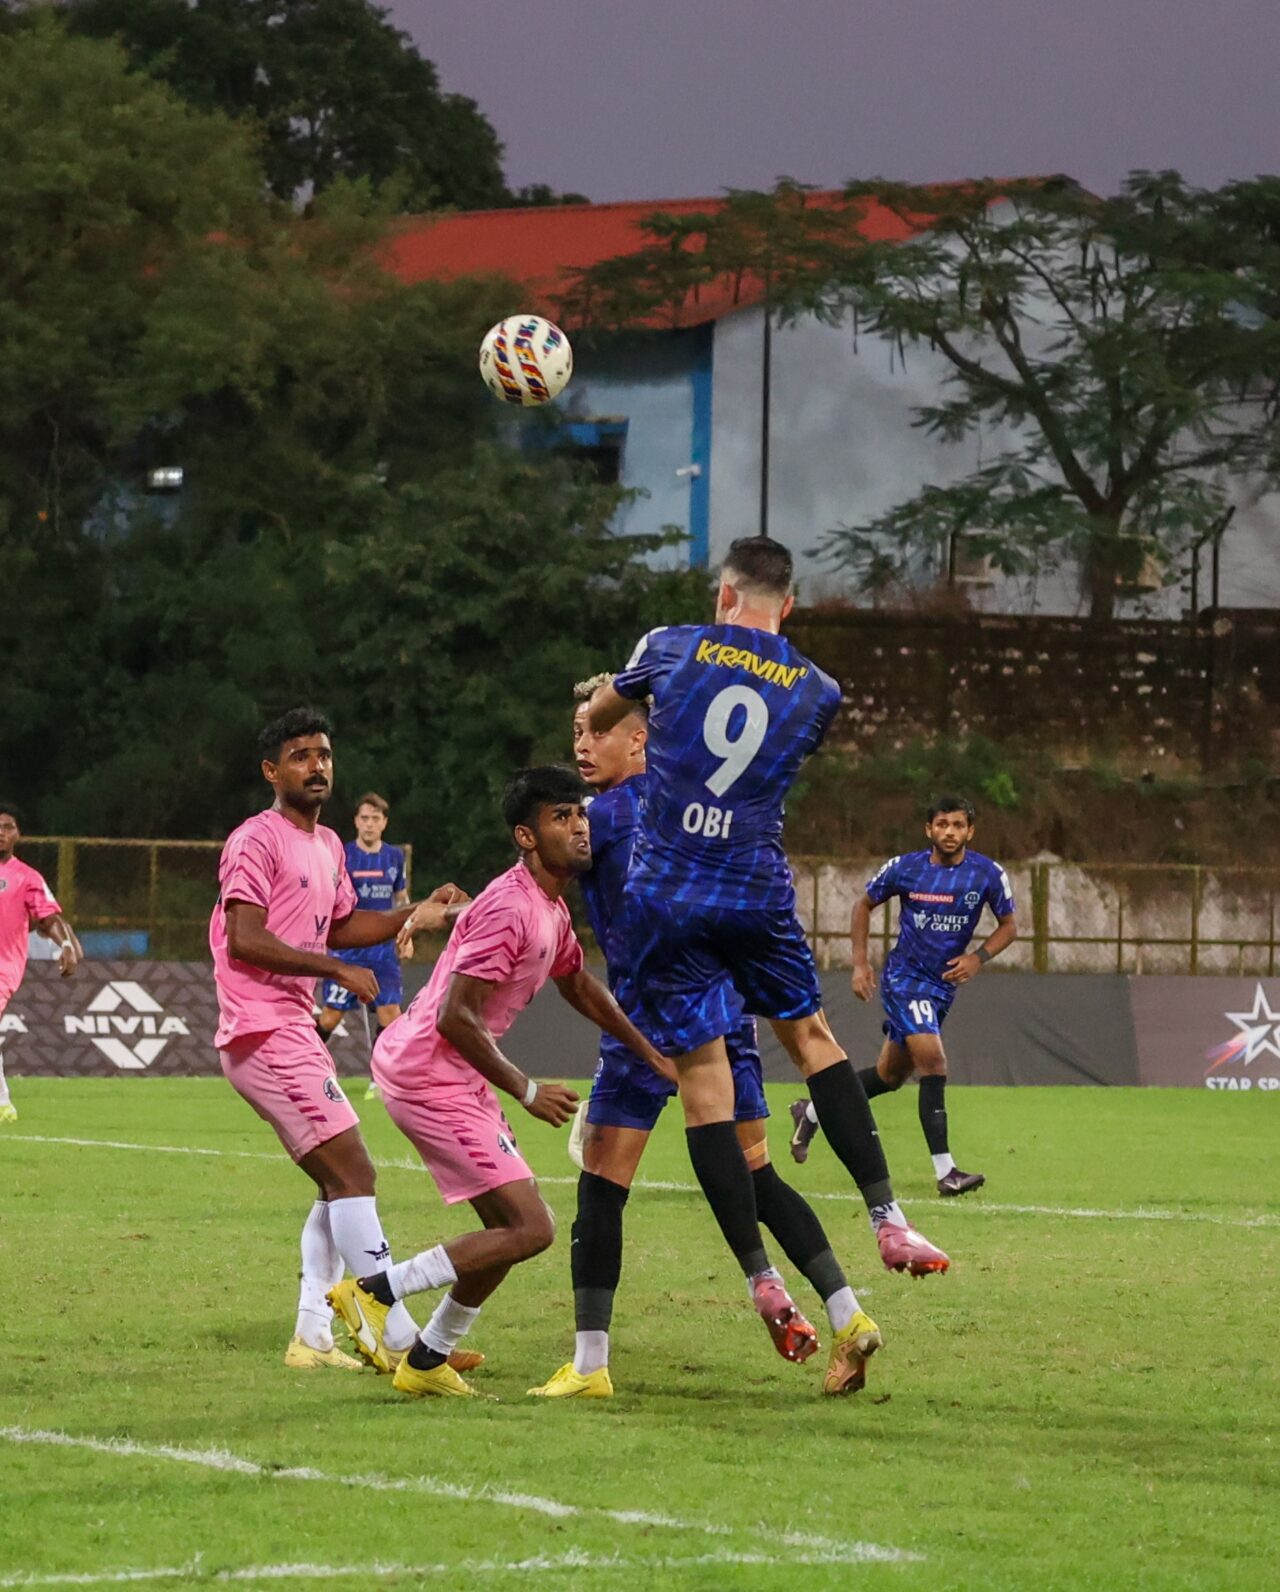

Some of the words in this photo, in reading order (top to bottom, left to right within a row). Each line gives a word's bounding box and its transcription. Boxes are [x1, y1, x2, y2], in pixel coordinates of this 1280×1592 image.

[696, 640, 808, 689] KRAVIN'
[703, 685, 769, 797] 9
[682, 802, 733, 839] OBI
[930, 922, 962, 932] GOLD
[932, 913, 969, 924] WHITE
[326, 983, 349, 1004] 22
[908, 999, 933, 1025] 19
[63, 1015, 191, 1035] NIVIA
